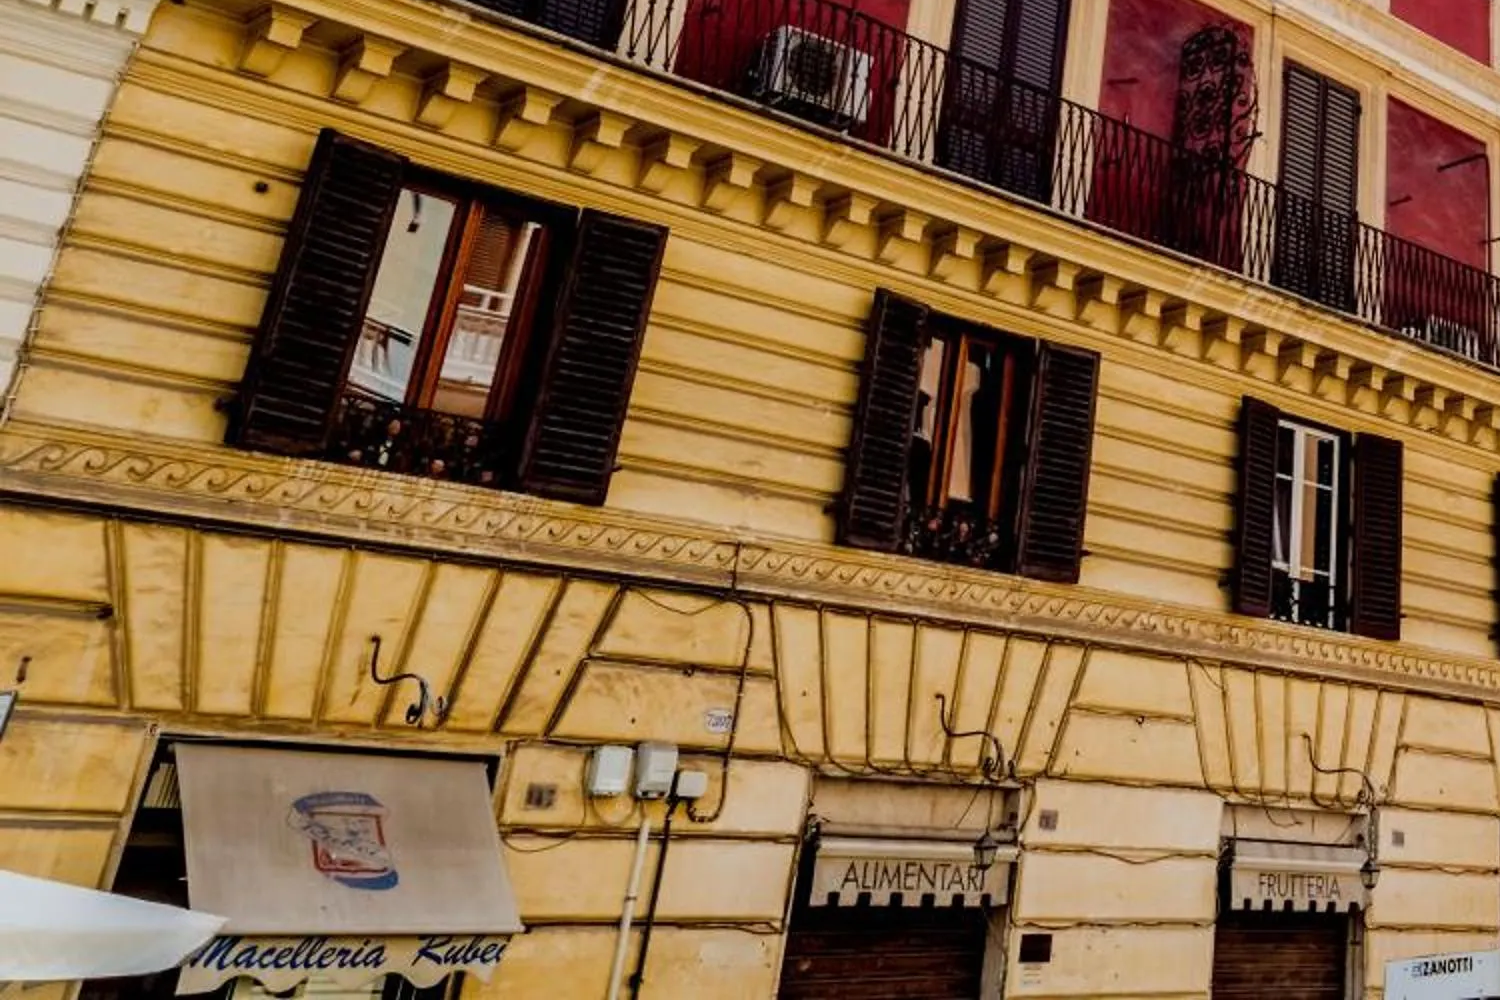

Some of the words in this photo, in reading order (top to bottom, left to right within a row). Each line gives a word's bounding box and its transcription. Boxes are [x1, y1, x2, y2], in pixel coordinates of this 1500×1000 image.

[841, 861, 985, 892] ALIMENTARI
[1258, 873, 1341, 900] FRUTTERIA
[191, 935, 387, 970] Macelleria
[1423, 956, 1473, 977] ZANOTTI
